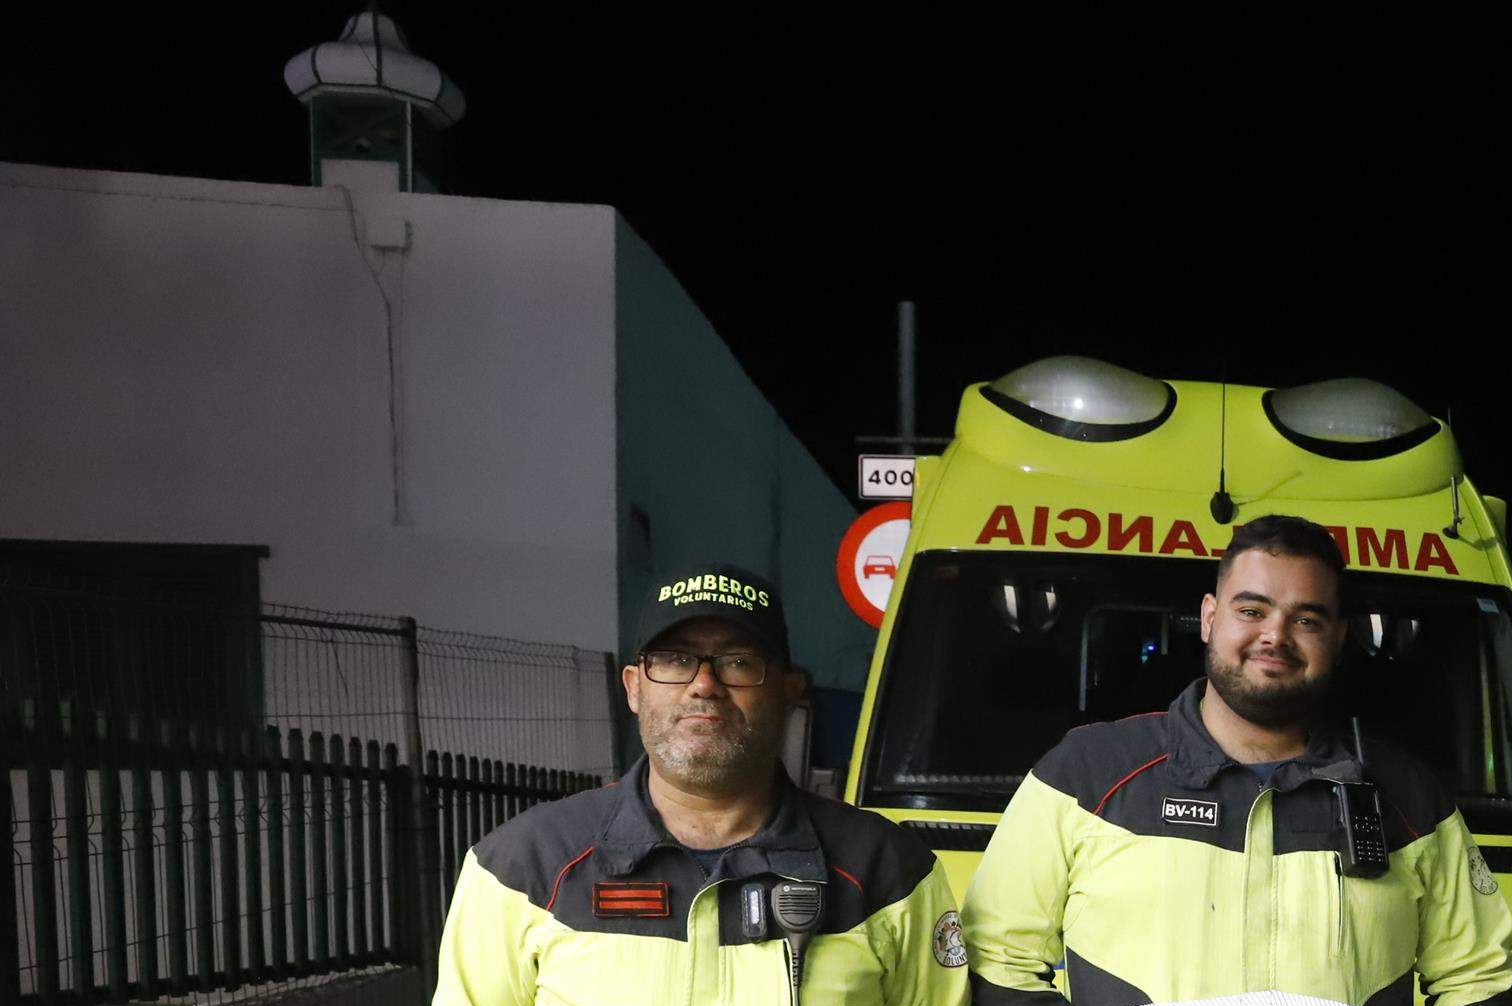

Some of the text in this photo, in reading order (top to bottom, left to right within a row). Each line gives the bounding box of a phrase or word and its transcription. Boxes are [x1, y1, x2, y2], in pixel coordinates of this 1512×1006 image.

[868, 469, 914, 485] 400
[658, 574, 769, 607] BOMBEROS
[674, 592, 753, 611] VOLUNTARIOS
[1165, 803, 1214, 820] BV-114
